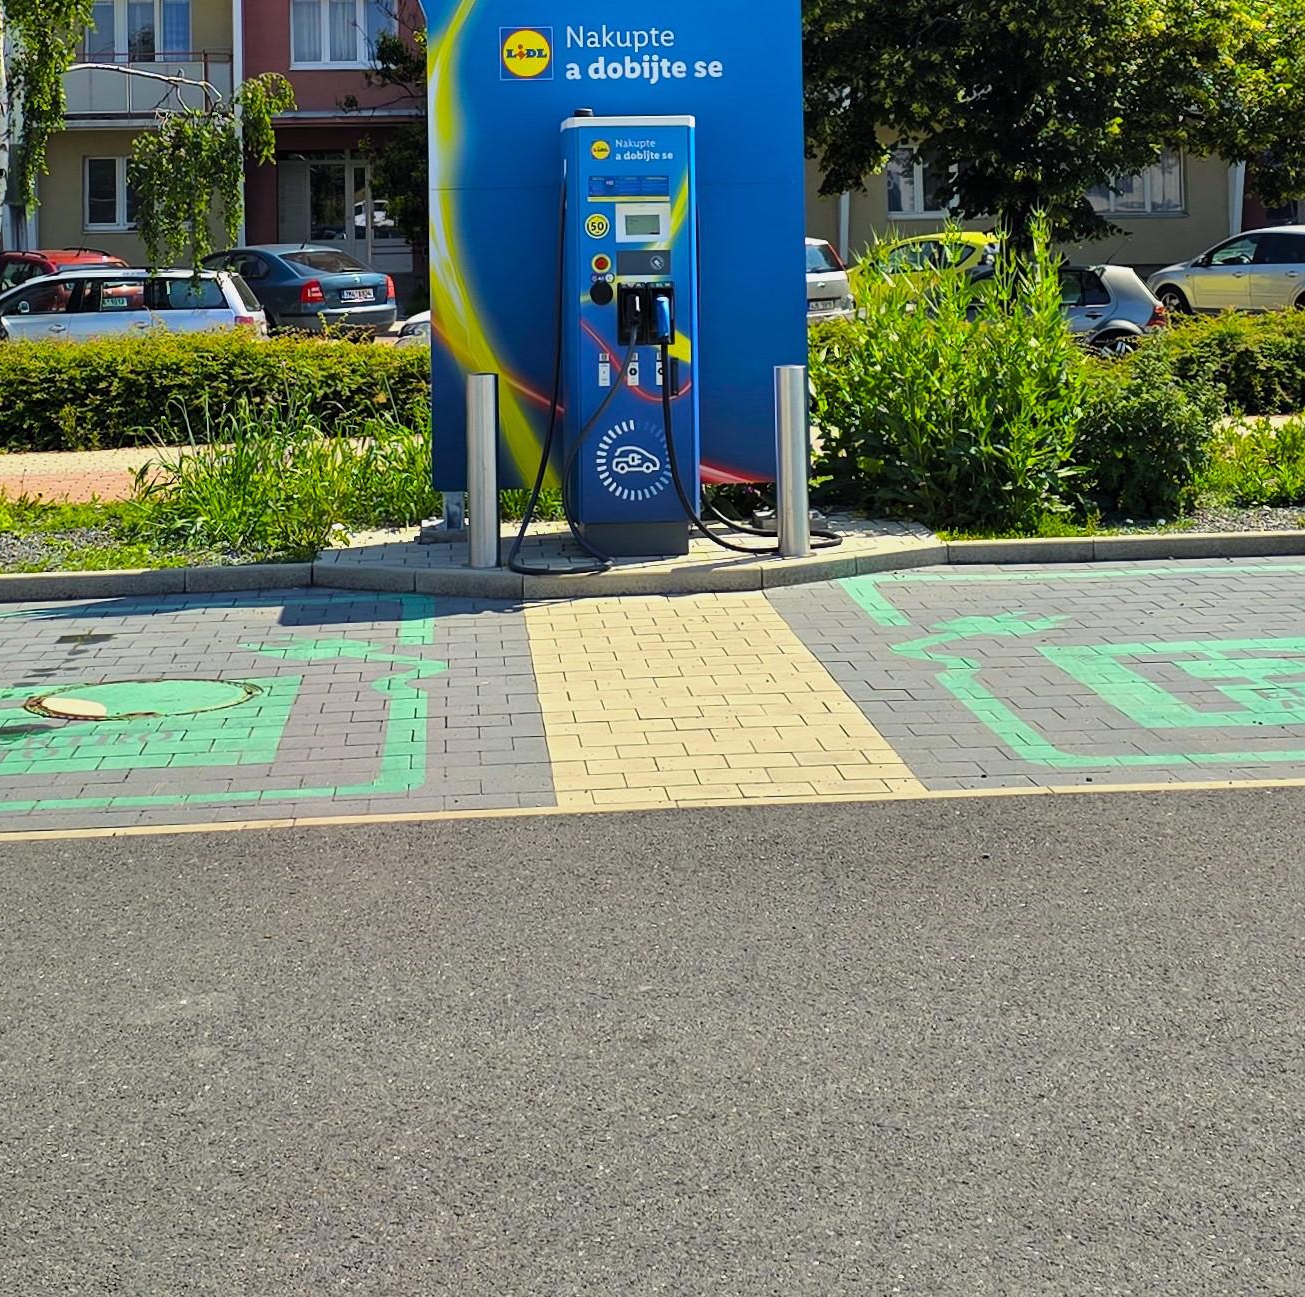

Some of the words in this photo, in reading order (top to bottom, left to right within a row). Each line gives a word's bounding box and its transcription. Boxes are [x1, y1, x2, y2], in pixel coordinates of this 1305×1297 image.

[566, 25, 675, 52] Nakupte
[565, 62, 582, 80] a
[588, 54, 687, 84] dobijte
[694, 59, 723, 78] se
[615, 139, 656, 149] Nakupte
[662, 152, 674, 160] se
[591, 222, 604, 231] 50
